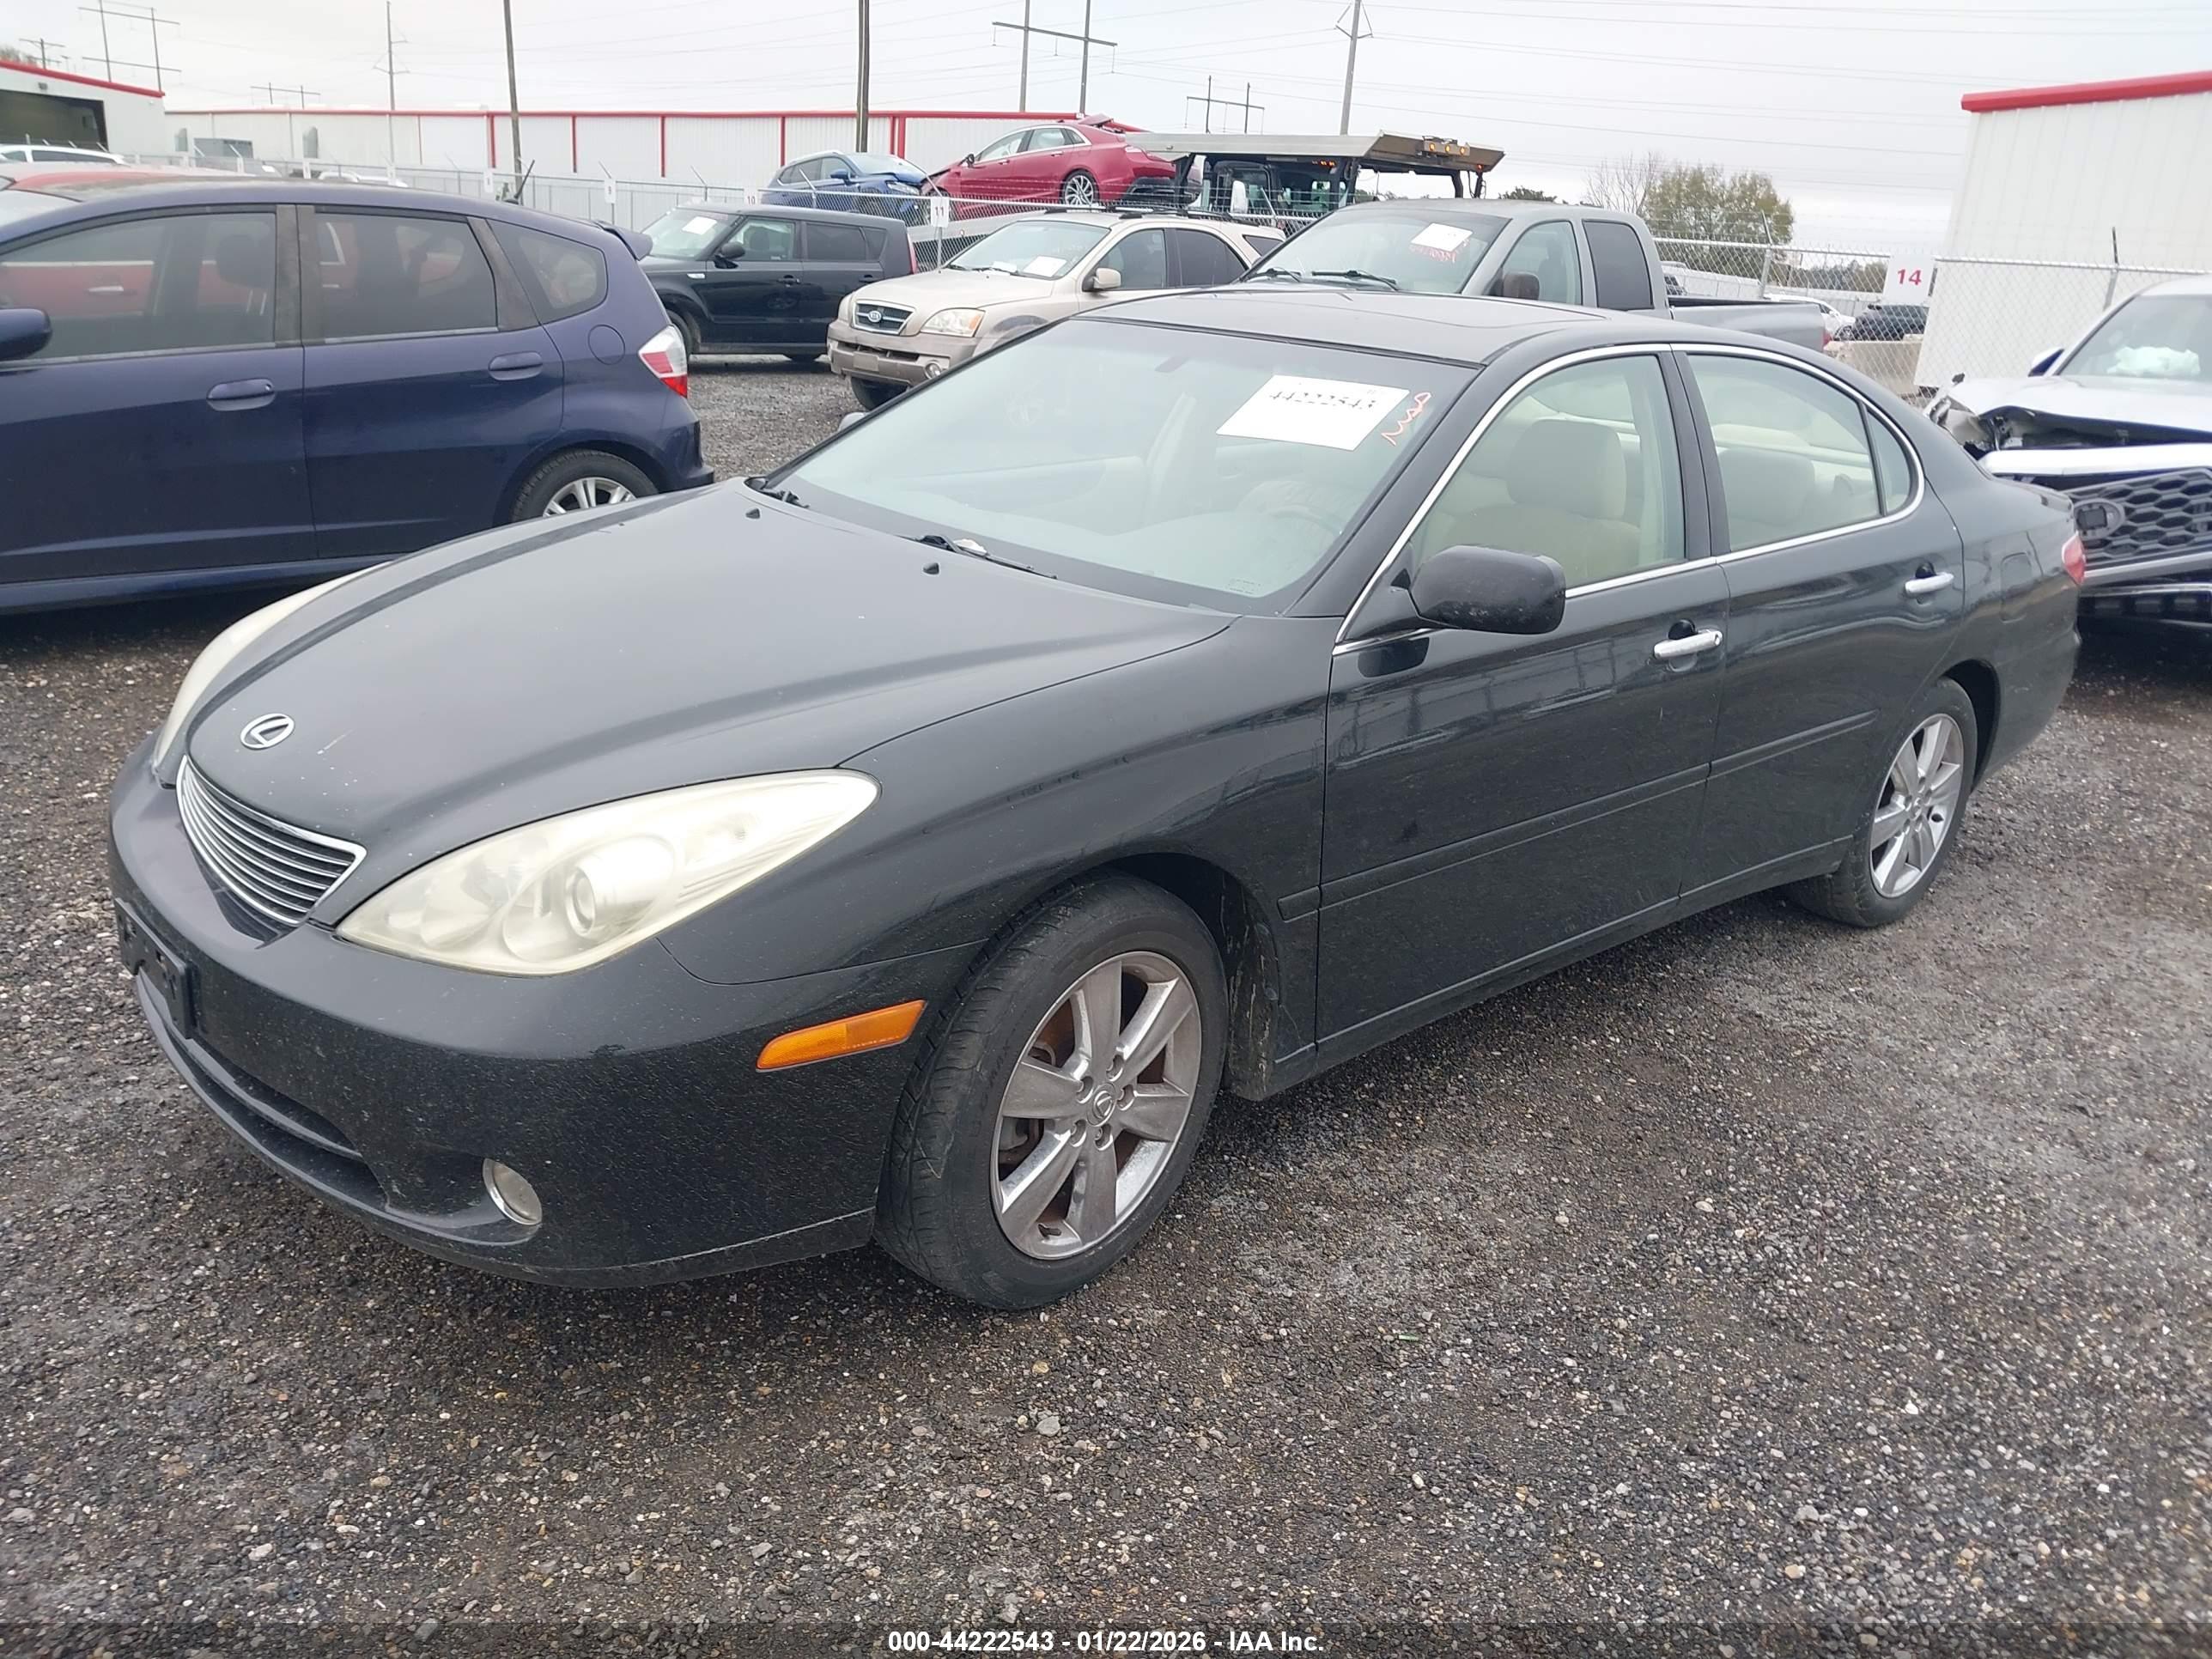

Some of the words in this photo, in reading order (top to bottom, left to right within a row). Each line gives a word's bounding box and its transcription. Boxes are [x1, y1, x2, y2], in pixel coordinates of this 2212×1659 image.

[747, 195, 756, 205] 10
[935, 205, 945, 216] 11
[1897, 268, 1922, 285] 14
